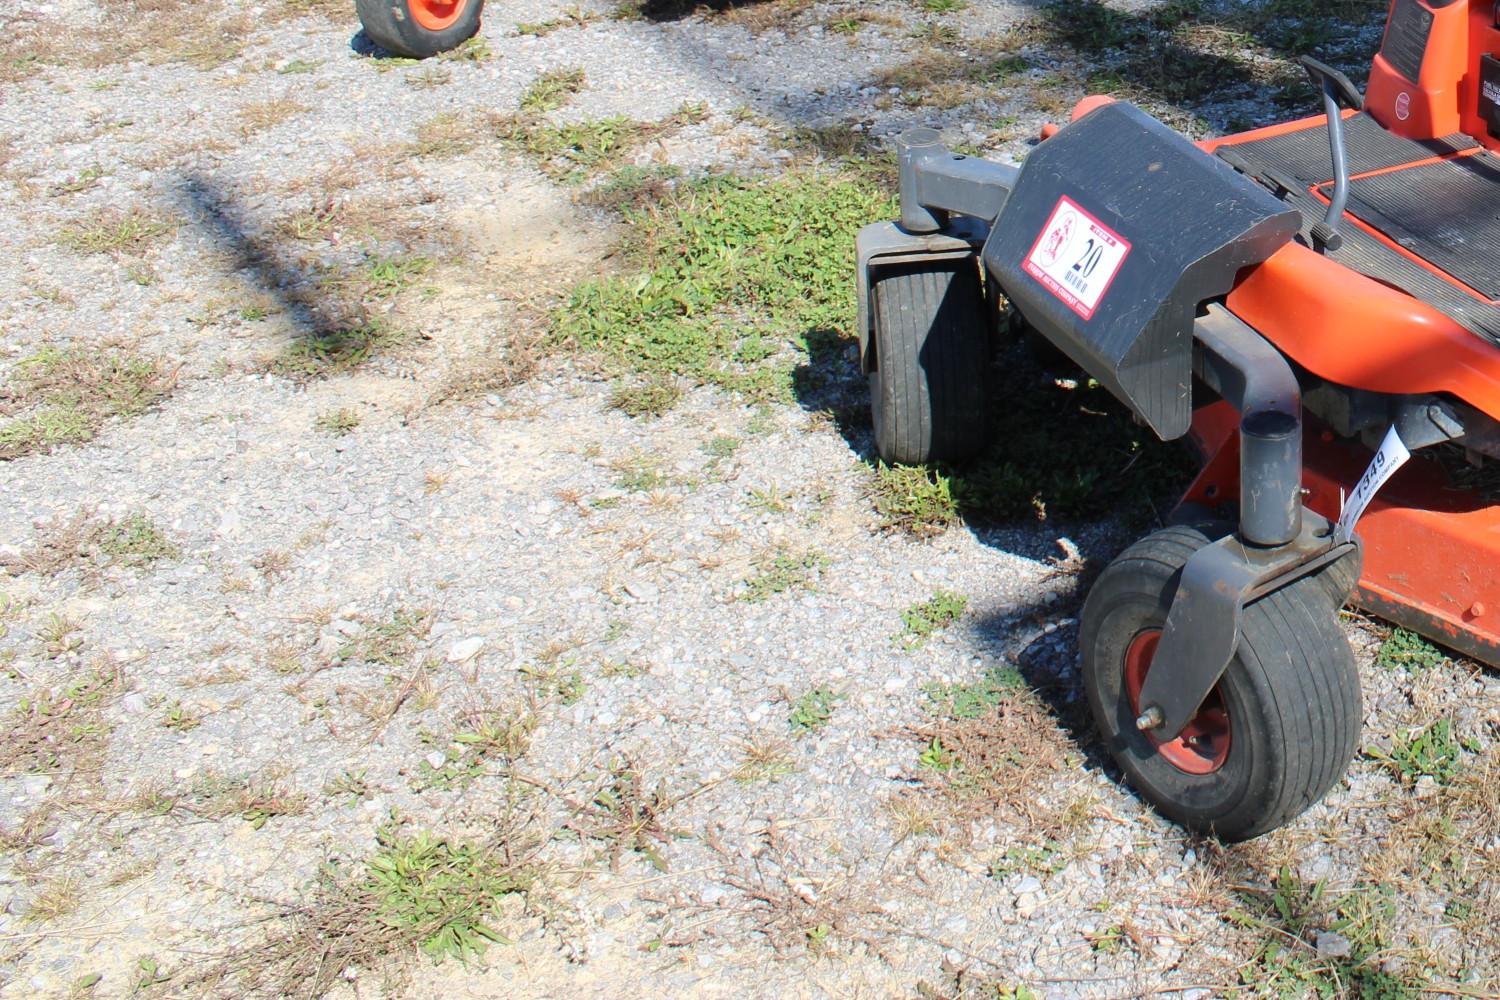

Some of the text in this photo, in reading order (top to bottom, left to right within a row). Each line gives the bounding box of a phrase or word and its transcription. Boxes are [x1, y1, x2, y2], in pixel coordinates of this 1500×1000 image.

[1072, 238, 1104, 279] 20
[1058, 287, 1078, 306] COMPANY
[1355, 450, 1386, 500] 1349
[1378, 456, 1400, 480] COMPANY
